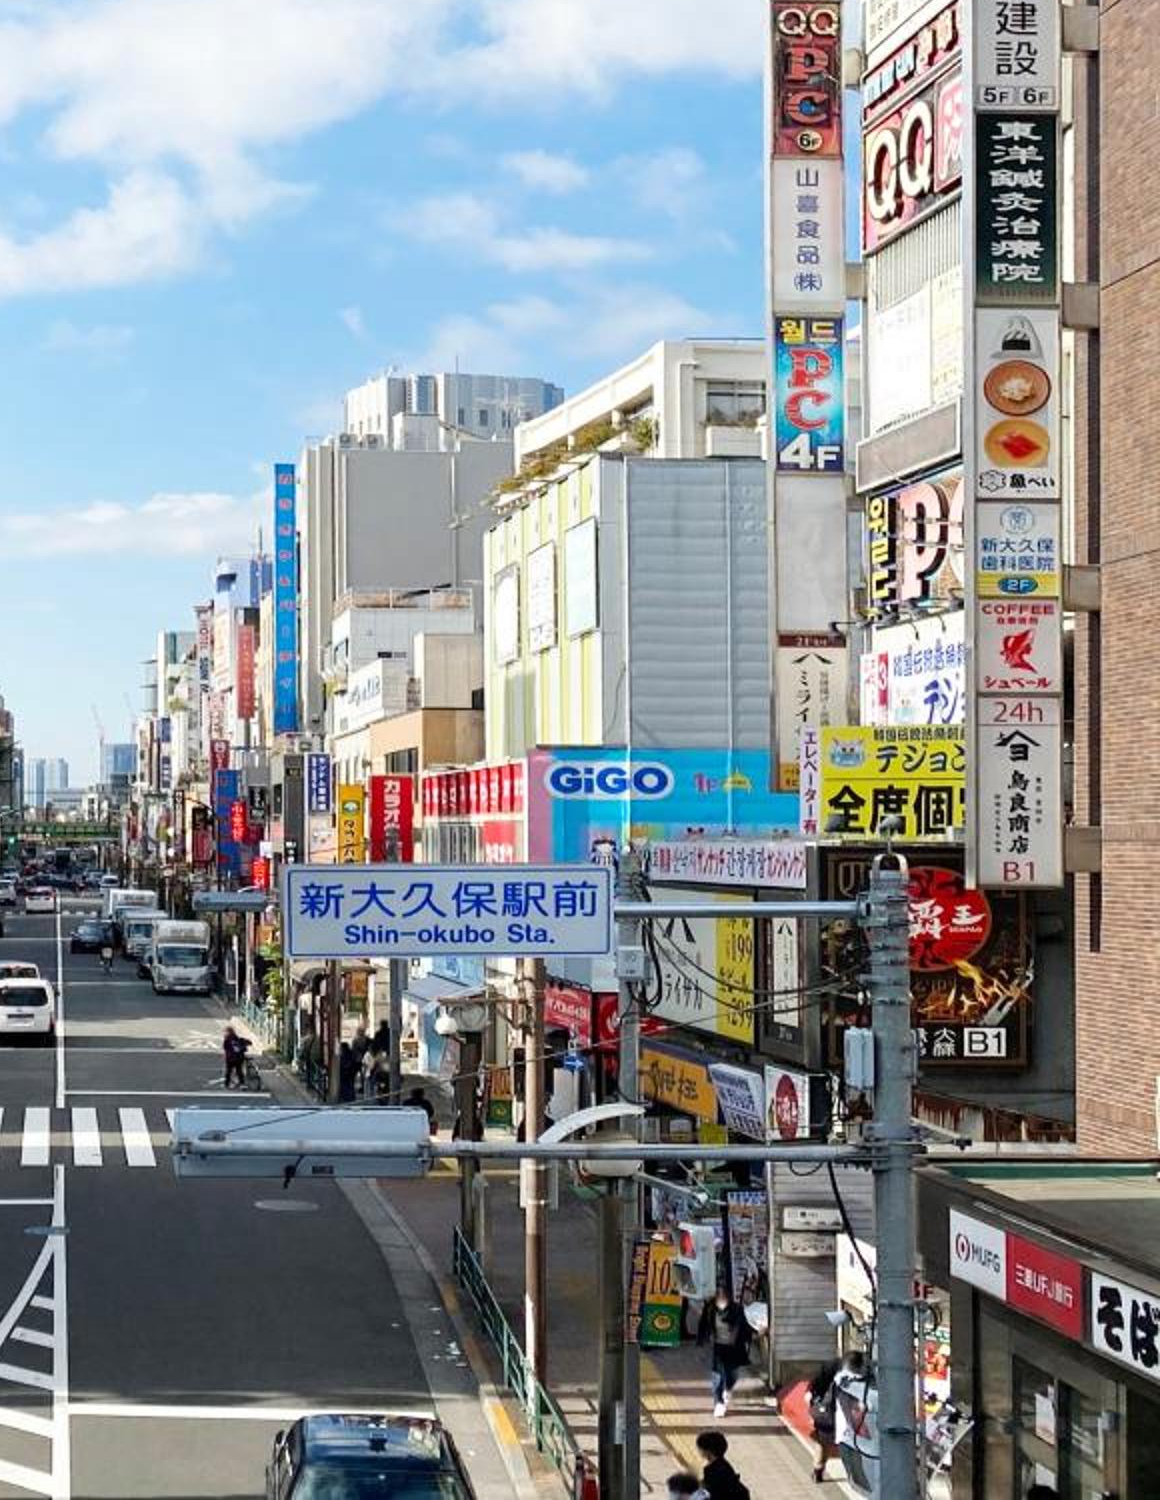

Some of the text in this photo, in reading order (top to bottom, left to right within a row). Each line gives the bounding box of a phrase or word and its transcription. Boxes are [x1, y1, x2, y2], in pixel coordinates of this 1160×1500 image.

[778, 8, 838, 36] QQ
[983, 87, 1049, 105] 5F 6F
[867, 100, 933, 221] QQ
[785, 347, 832, 431] PC
[779, 432, 840, 469] 4F
[1009, 473, 1055, 489] 魚べい
[981, 537, 1055, 554] 新大久保
[1006, 577, 1031, 592] 2F
[981, 603, 1055, 615] COFFEE
[993, 701, 1044, 723] 24h
[549, 766, 669, 794] GiGO
[824, 784, 966, 836] 全席個
[1003, 862, 1035, 882] B1
[299, 881, 599, 919] 新大久保駅前
[344, 924, 556, 944] Shin-okubo Sta.
[969, 1031, 1003, 1054] B1
[971, 1243, 1001, 1274] MUFG
